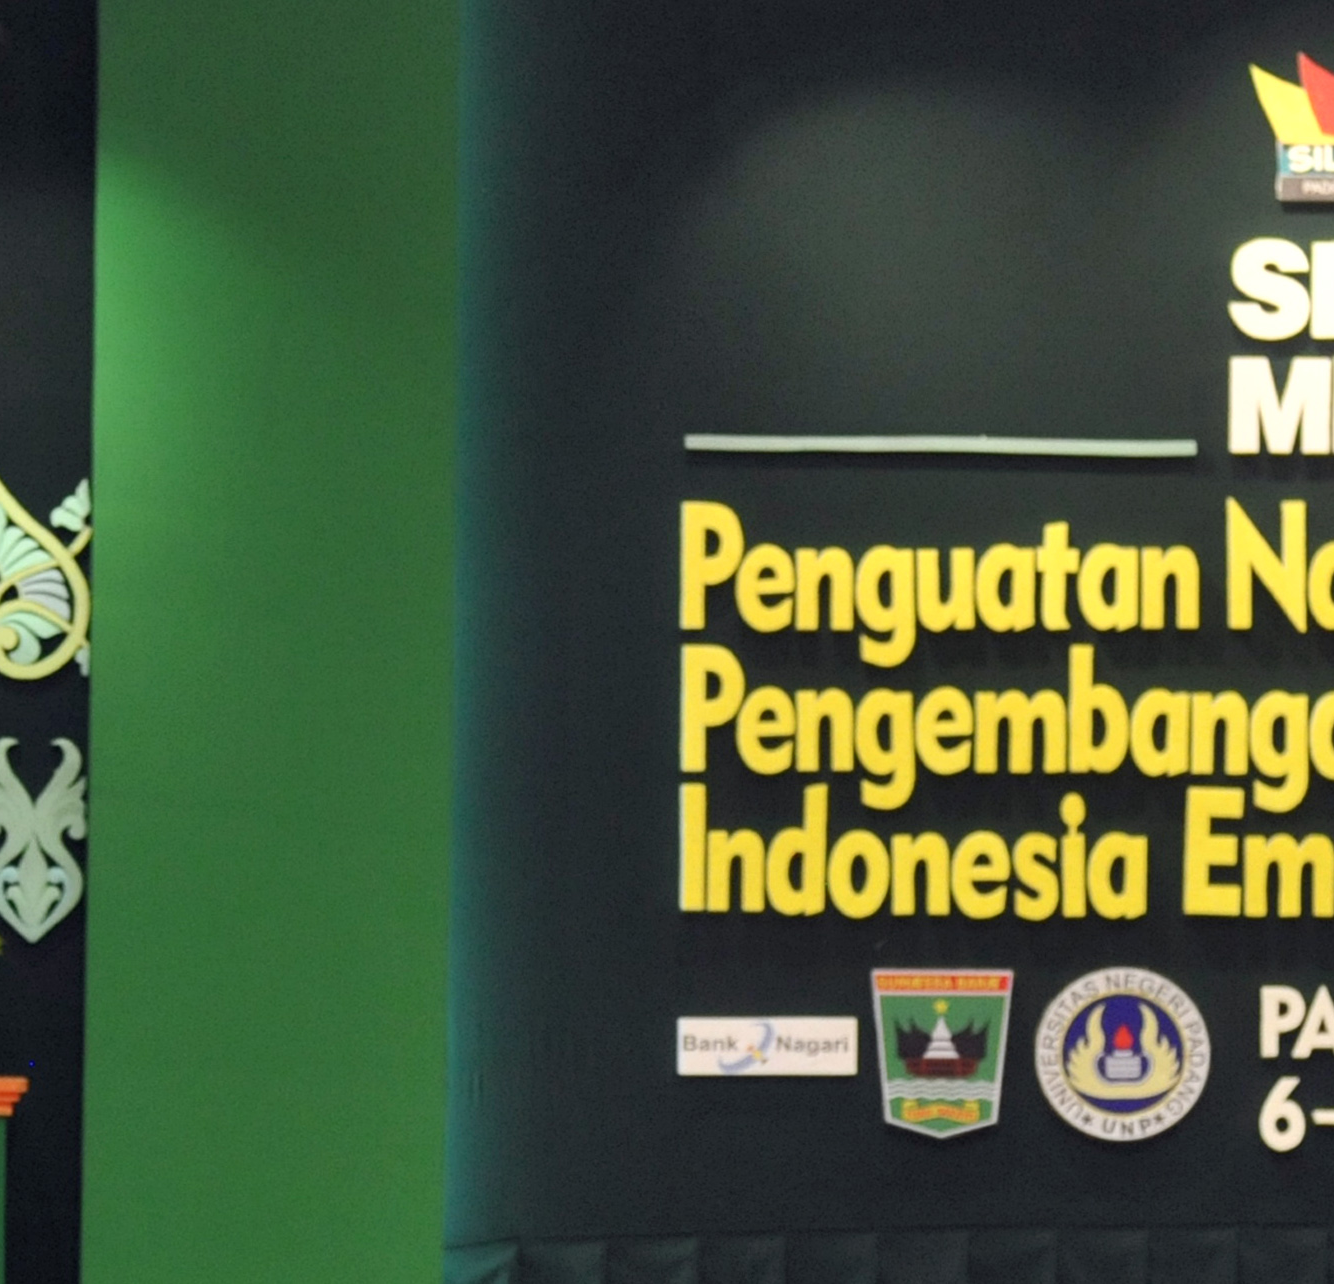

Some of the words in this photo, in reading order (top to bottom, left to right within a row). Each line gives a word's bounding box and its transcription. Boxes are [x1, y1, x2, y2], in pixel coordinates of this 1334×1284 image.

[680, 500, 1200, 668] Penguatan
[679, 783, 1148, 919] Indonesia
[683, 1035, 739, 1052] Bank
[776, 1035, 849, 1058] Nagari
[1040, 980, 1099, 1122] UNIVERSITAS
[1105, 974, 1190, 1018] NEGERI
[1167, 1023, 1206, 1117] PADANG
[1101, 1117, 1152, 1136] UNP
